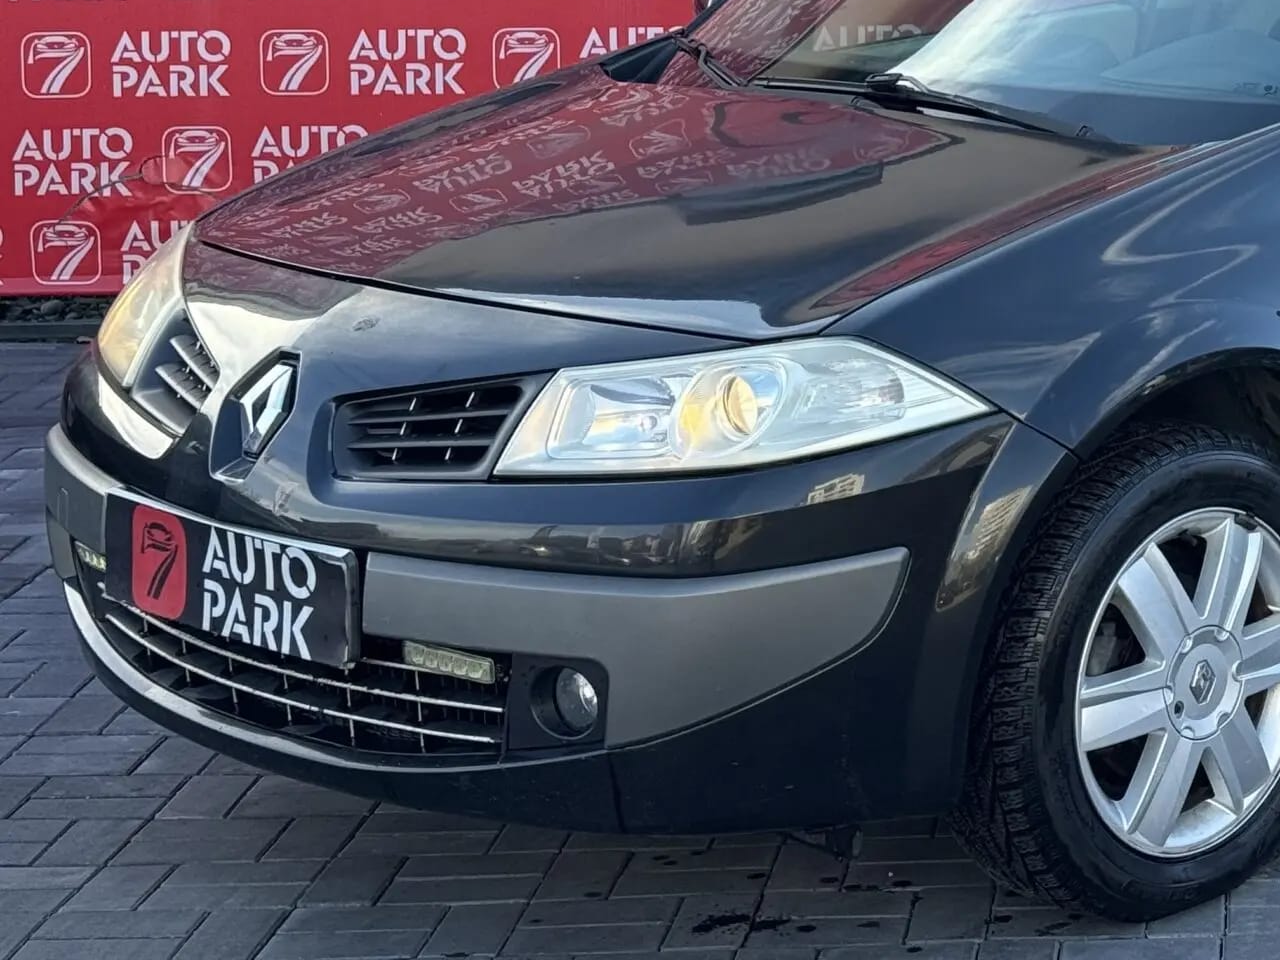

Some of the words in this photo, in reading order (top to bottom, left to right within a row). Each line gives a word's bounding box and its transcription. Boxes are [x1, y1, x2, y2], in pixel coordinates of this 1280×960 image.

[111, 30, 231, 62] AUTO
[348, 28, 466, 61] AUTO
[112, 64, 229, 97] PARK
[350, 62, 465, 95] PARK
[13, 127, 133, 161] AUTO
[14, 161, 132, 197] PARK
[202, 525, 317, 600] AUTO
[202, 578, 315, 660] PARK
